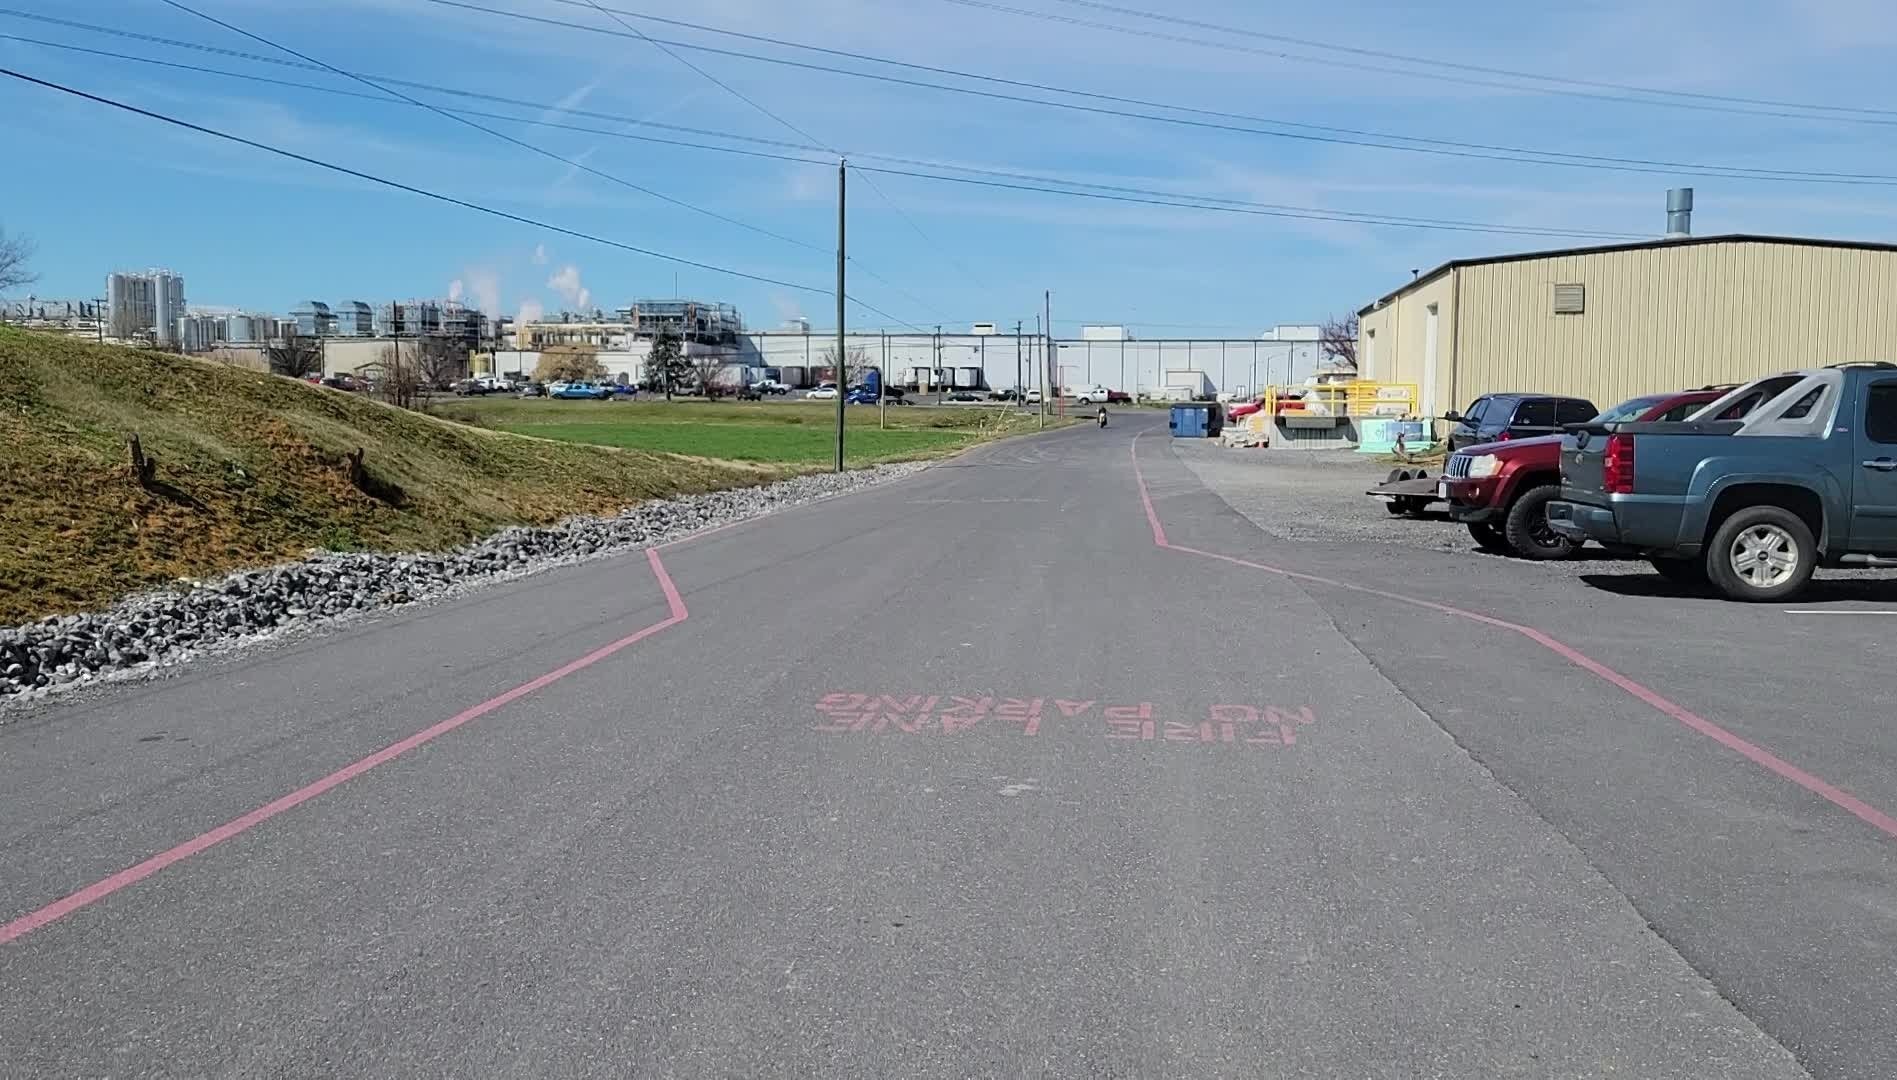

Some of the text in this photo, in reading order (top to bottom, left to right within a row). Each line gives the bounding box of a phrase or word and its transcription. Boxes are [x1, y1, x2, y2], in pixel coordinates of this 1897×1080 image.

[815, 692, 1314, 724] NO PARKING
[815, 711, 1298, 745] FIRE LANE
